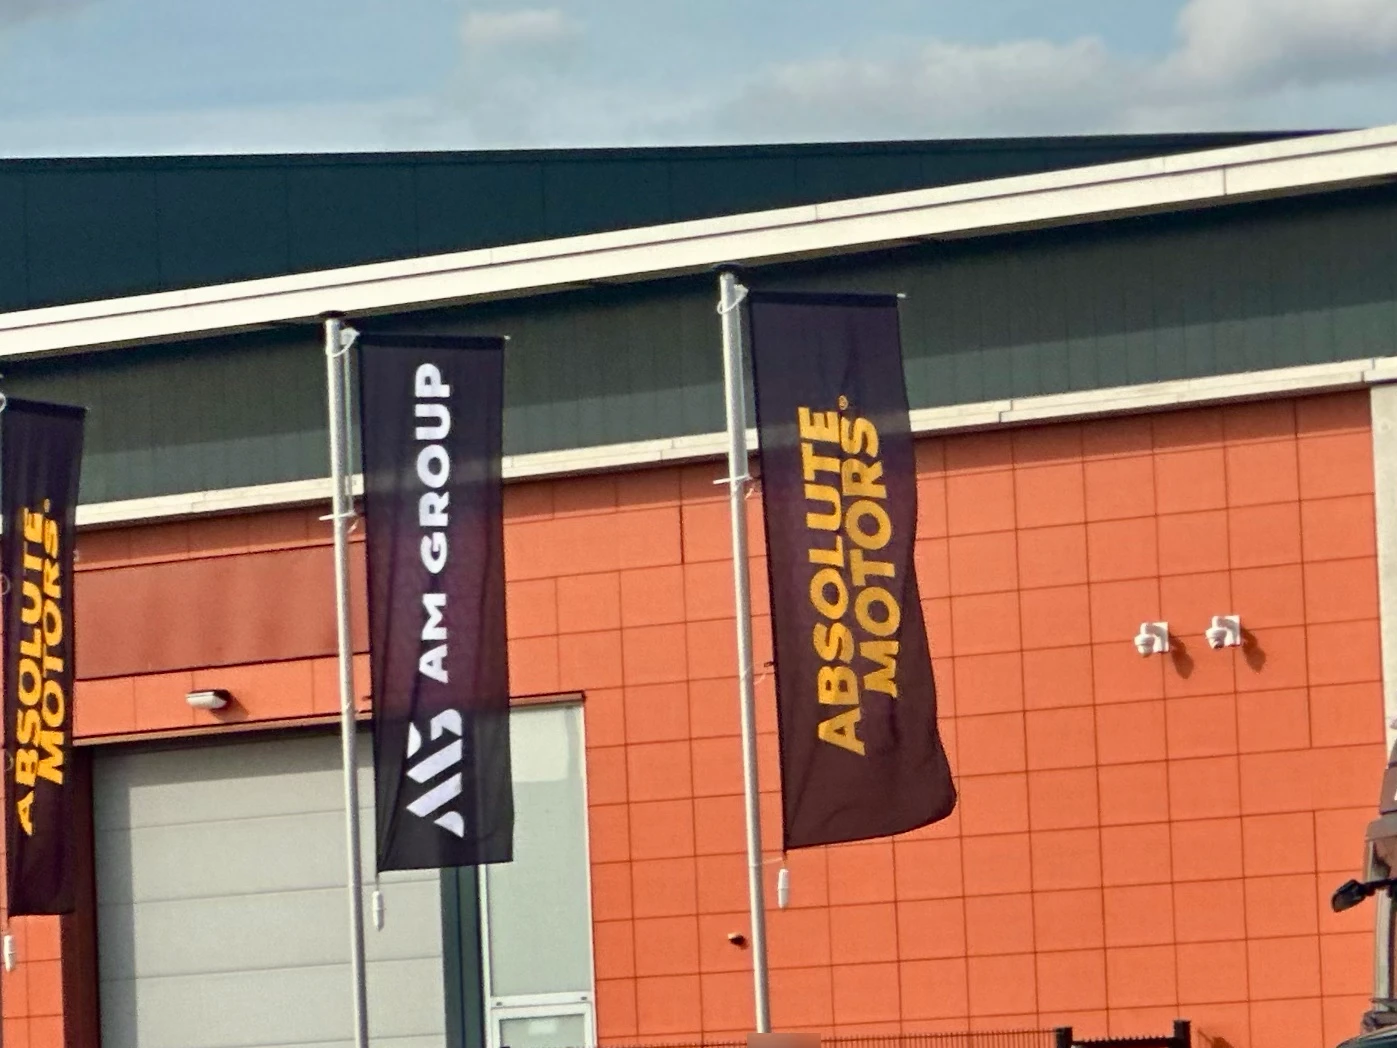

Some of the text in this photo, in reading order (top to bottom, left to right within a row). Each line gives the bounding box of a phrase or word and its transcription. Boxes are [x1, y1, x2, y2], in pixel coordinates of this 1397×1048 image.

[15, 507, 43, 837] ABSOLUTE
[37, 518, 65, 785] MOTORS
[414, 362, 451, 684] AM GROUP
[798, 406, 865, 756] ABSOLUTE
[840, 416, 901, 699] MOTORS
